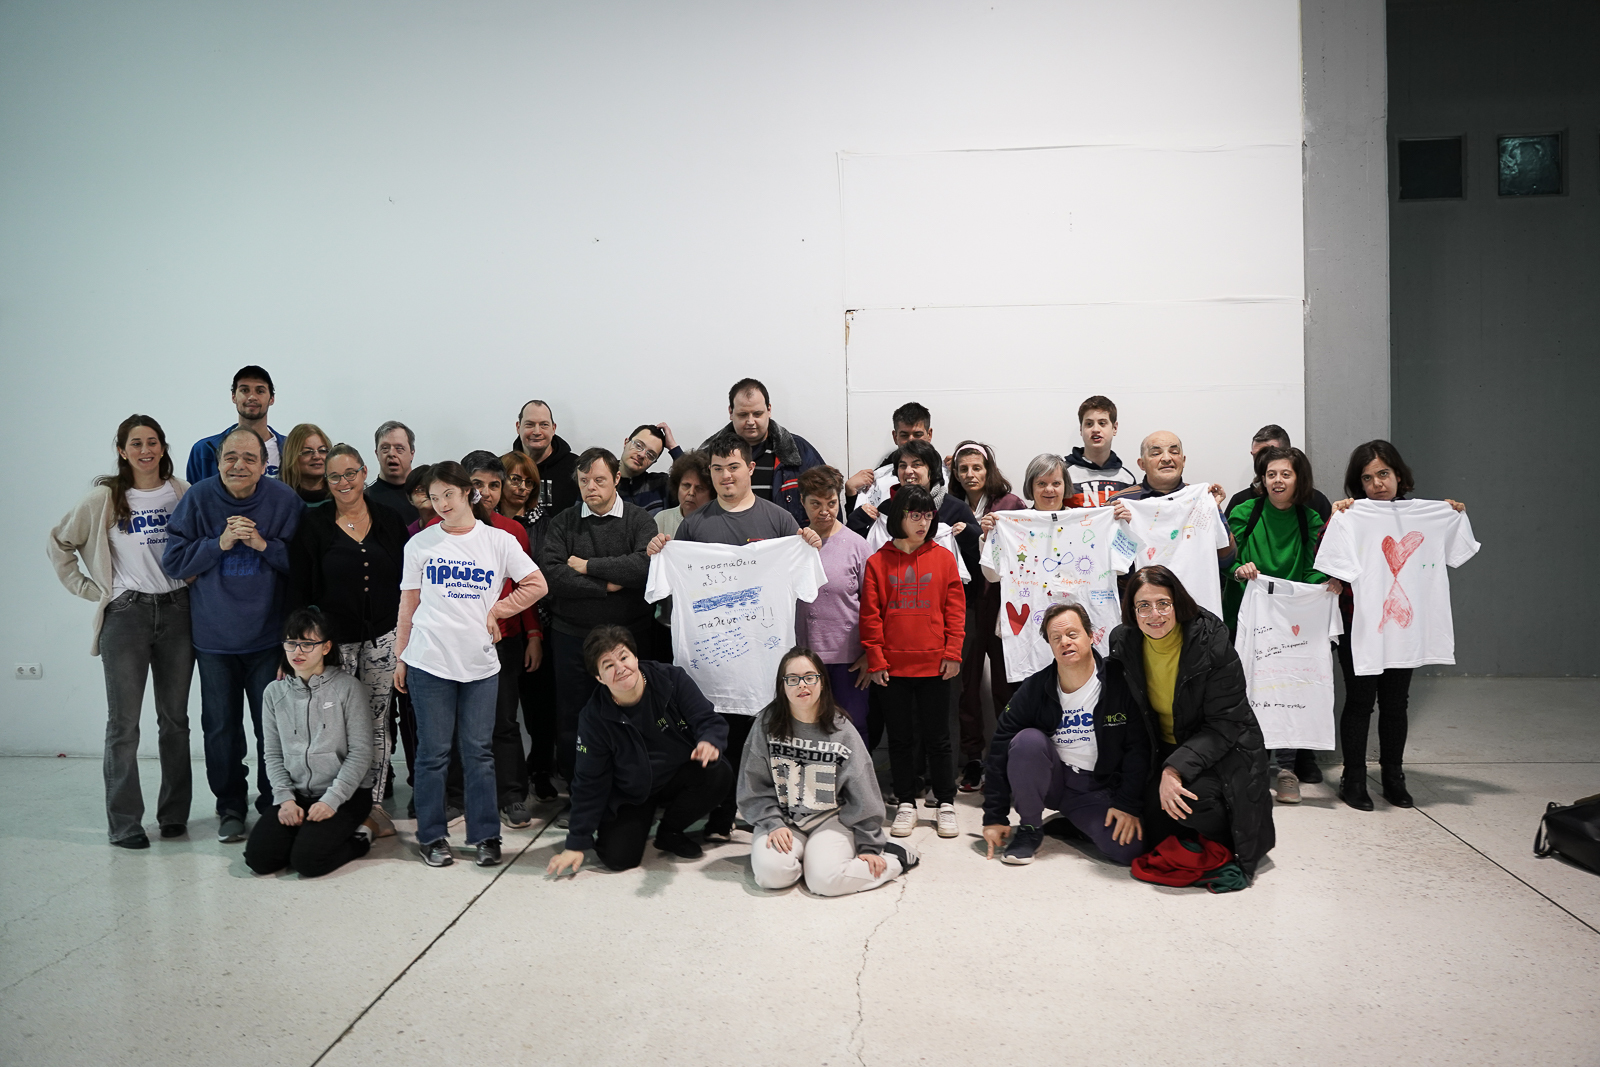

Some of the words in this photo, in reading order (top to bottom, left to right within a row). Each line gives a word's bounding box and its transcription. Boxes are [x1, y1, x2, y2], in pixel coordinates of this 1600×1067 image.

[142, 507, 167, 515] μικροί
[427, 559, 494, 587] ήρωες
[446, 582, 487, 590] μαθαίνουν
[448, 591, 480, 599] Stoiximan
[888, 597, 931, 609] adidas
